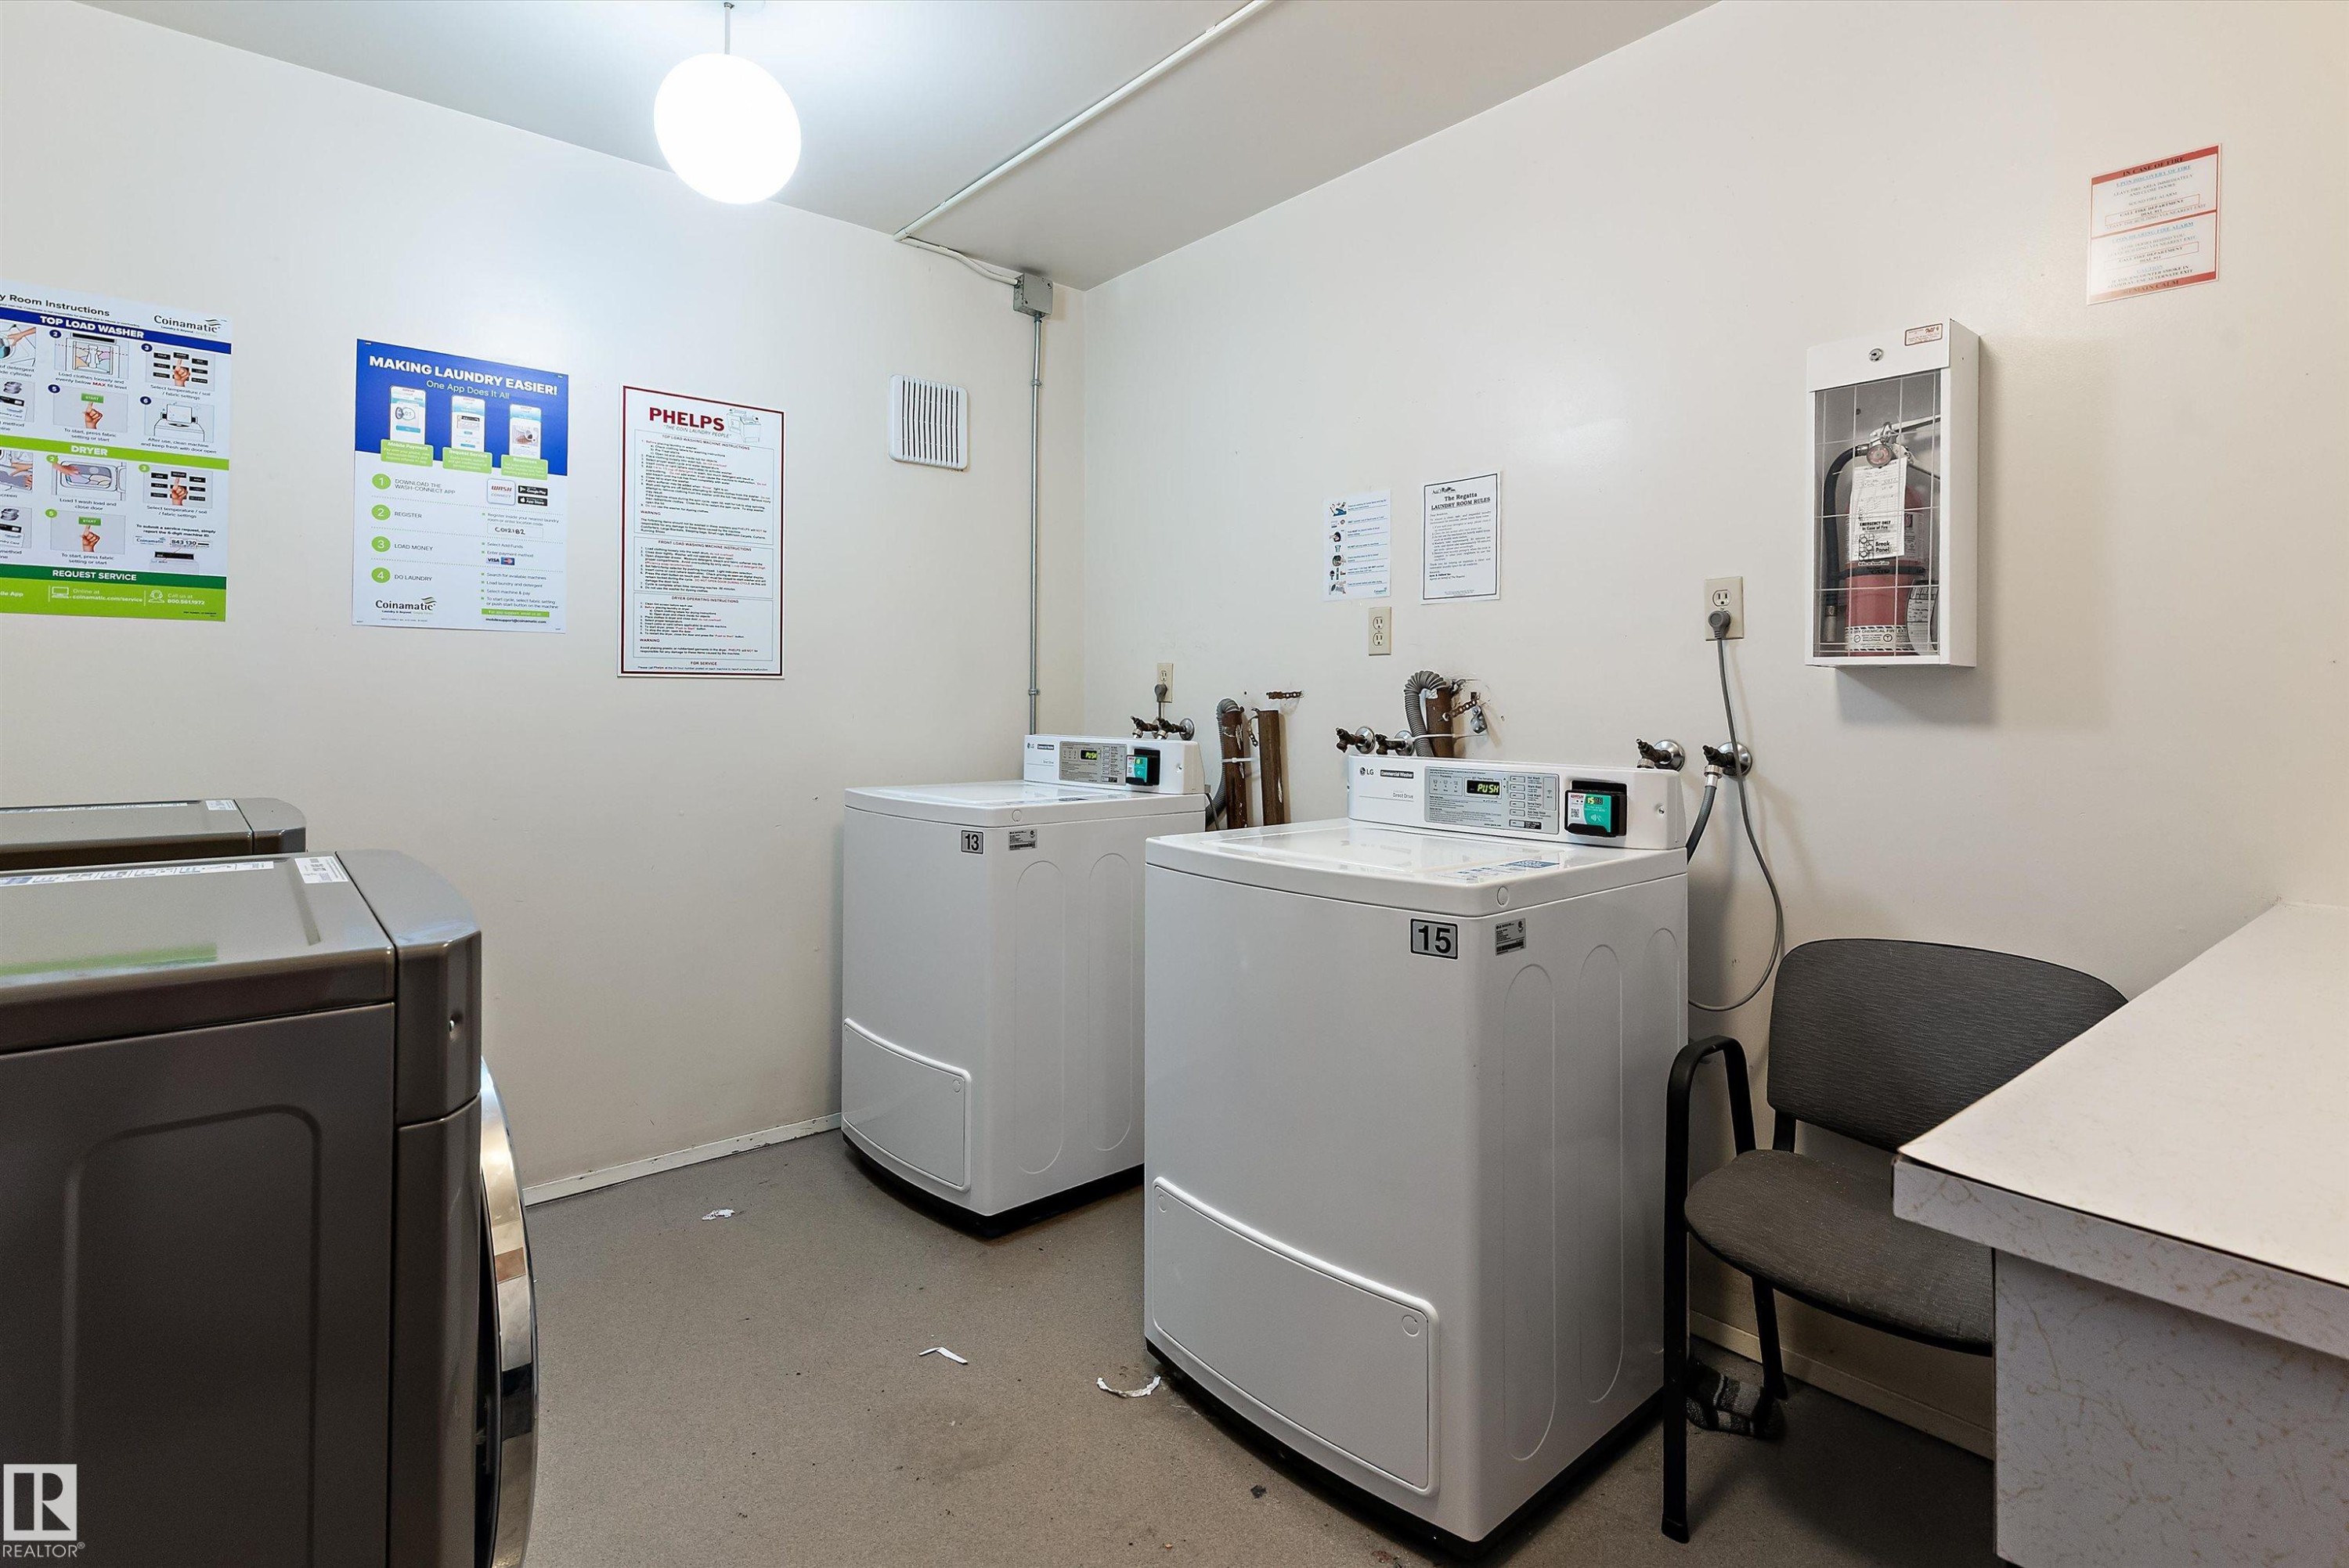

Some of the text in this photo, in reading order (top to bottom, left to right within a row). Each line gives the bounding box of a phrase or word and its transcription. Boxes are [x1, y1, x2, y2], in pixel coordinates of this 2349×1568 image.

[2133, 166, 2151, 175] CASE
[2167, 156, 2185, 167] FIRE
[9, 294, 41, 305] Room
[46, 300, 110, 317] Instructions
[40, 315, 63, 325] TOP
[66, 319, 96, 330] LOAD
[98, 324, 144, 338] WASHER
[153, 315, 218, 333] Coinamatic
[370, 355, 557, 395] MAKING LAUNDRY EASIER!
[427, 380, 444, 389] One
[447, 384, 464, 394] App
[467, 387, 489, 396] Does
[650, 407, 724, 431] PHELPS
[71, 445, 108, 456] DRYER
[395, 485, 442, 494] WASH-CONNECT
[1431, 502, 1455, 510] LAUNDRY
[52, 570, 137, 581] REQUEST SERVICE
[376, 600, 433, 611] Coinamatic
[1478, 784, 1499, 793] PUSH
[965, 834, 979, 851] 13
[1418, 925, 1451, 953] 15
